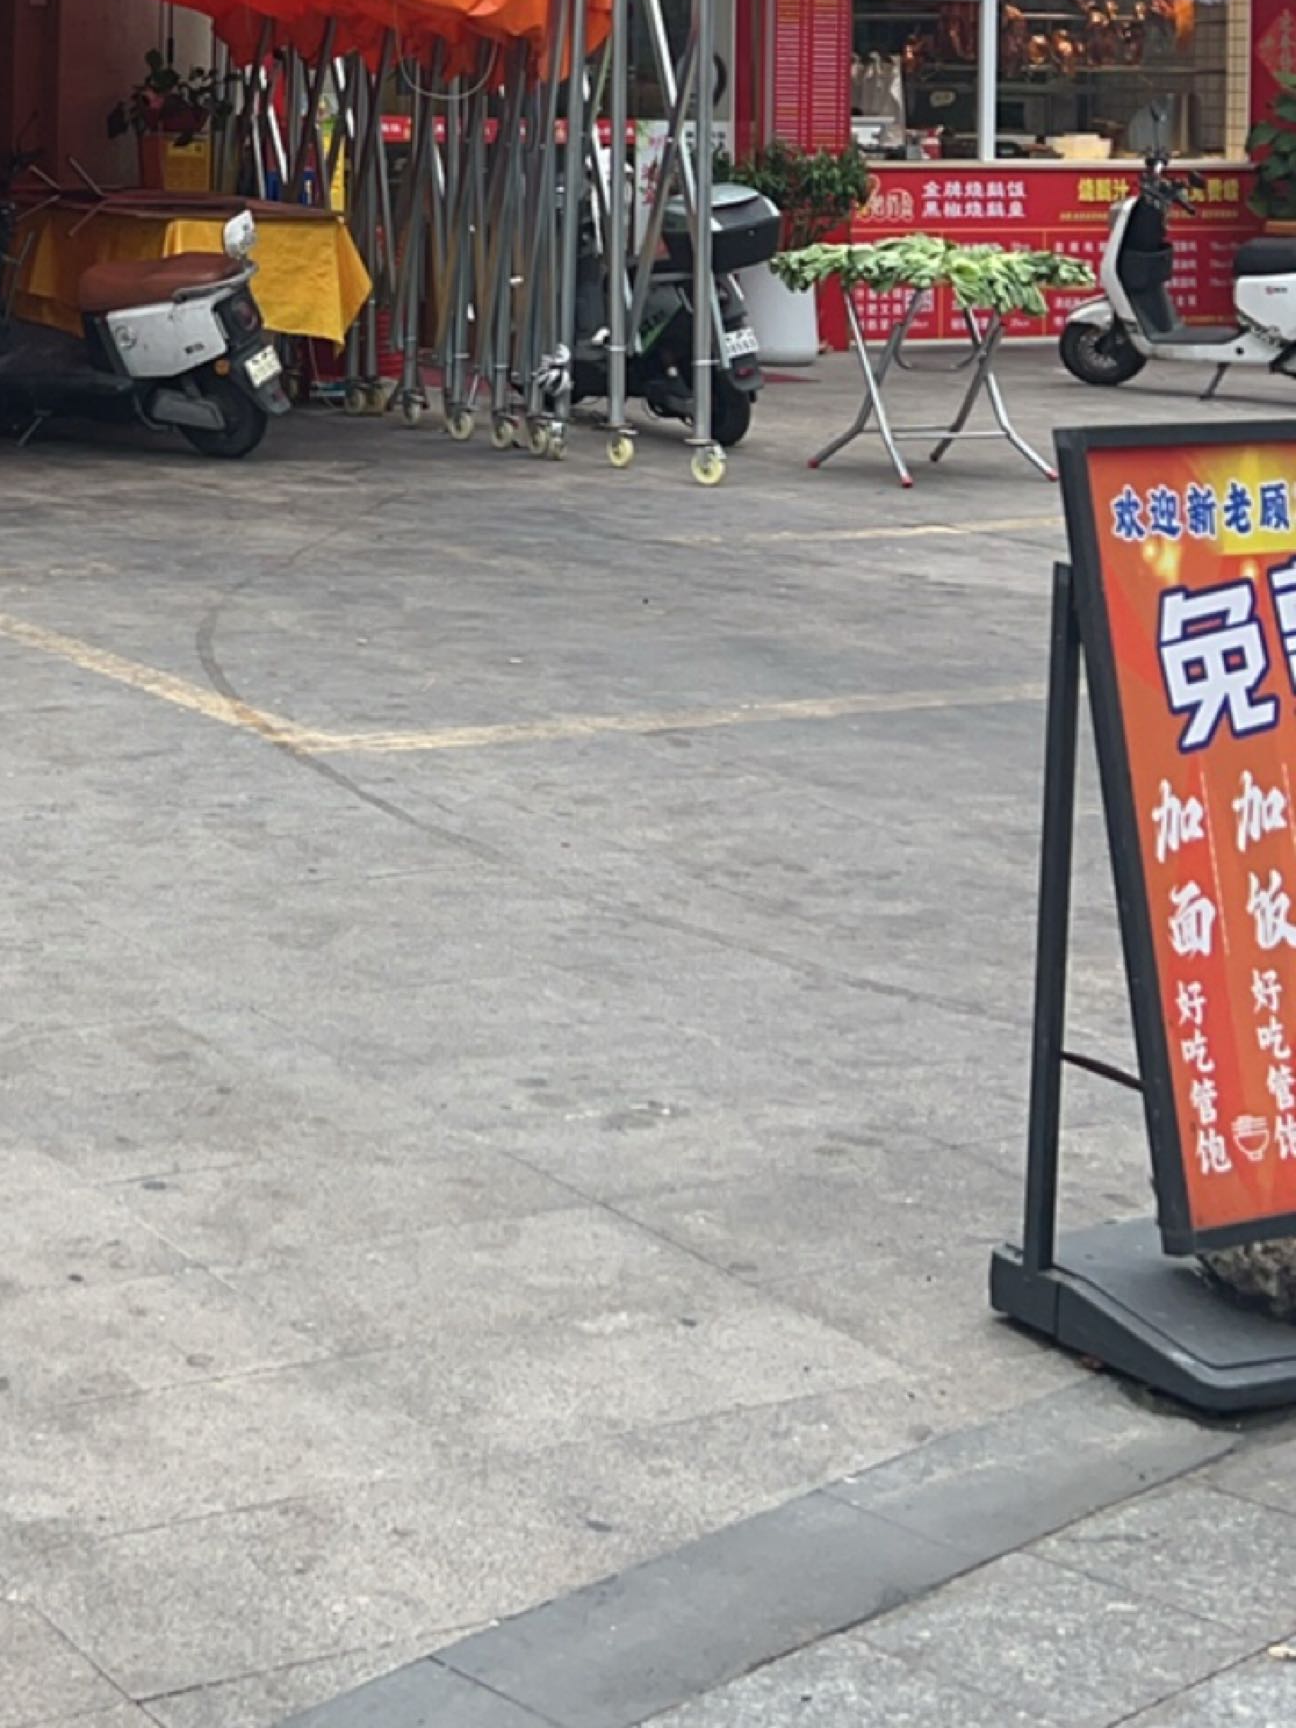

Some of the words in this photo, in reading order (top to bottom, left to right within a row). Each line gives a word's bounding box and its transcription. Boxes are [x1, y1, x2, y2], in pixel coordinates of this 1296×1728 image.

[1158, 552, 1296, 754] 免
[1152, 778, 1216, 958] 加面
[1232, 769, 1296, 950] 加饭
[1175, 978, 1232, 1174] 好吃管饱
